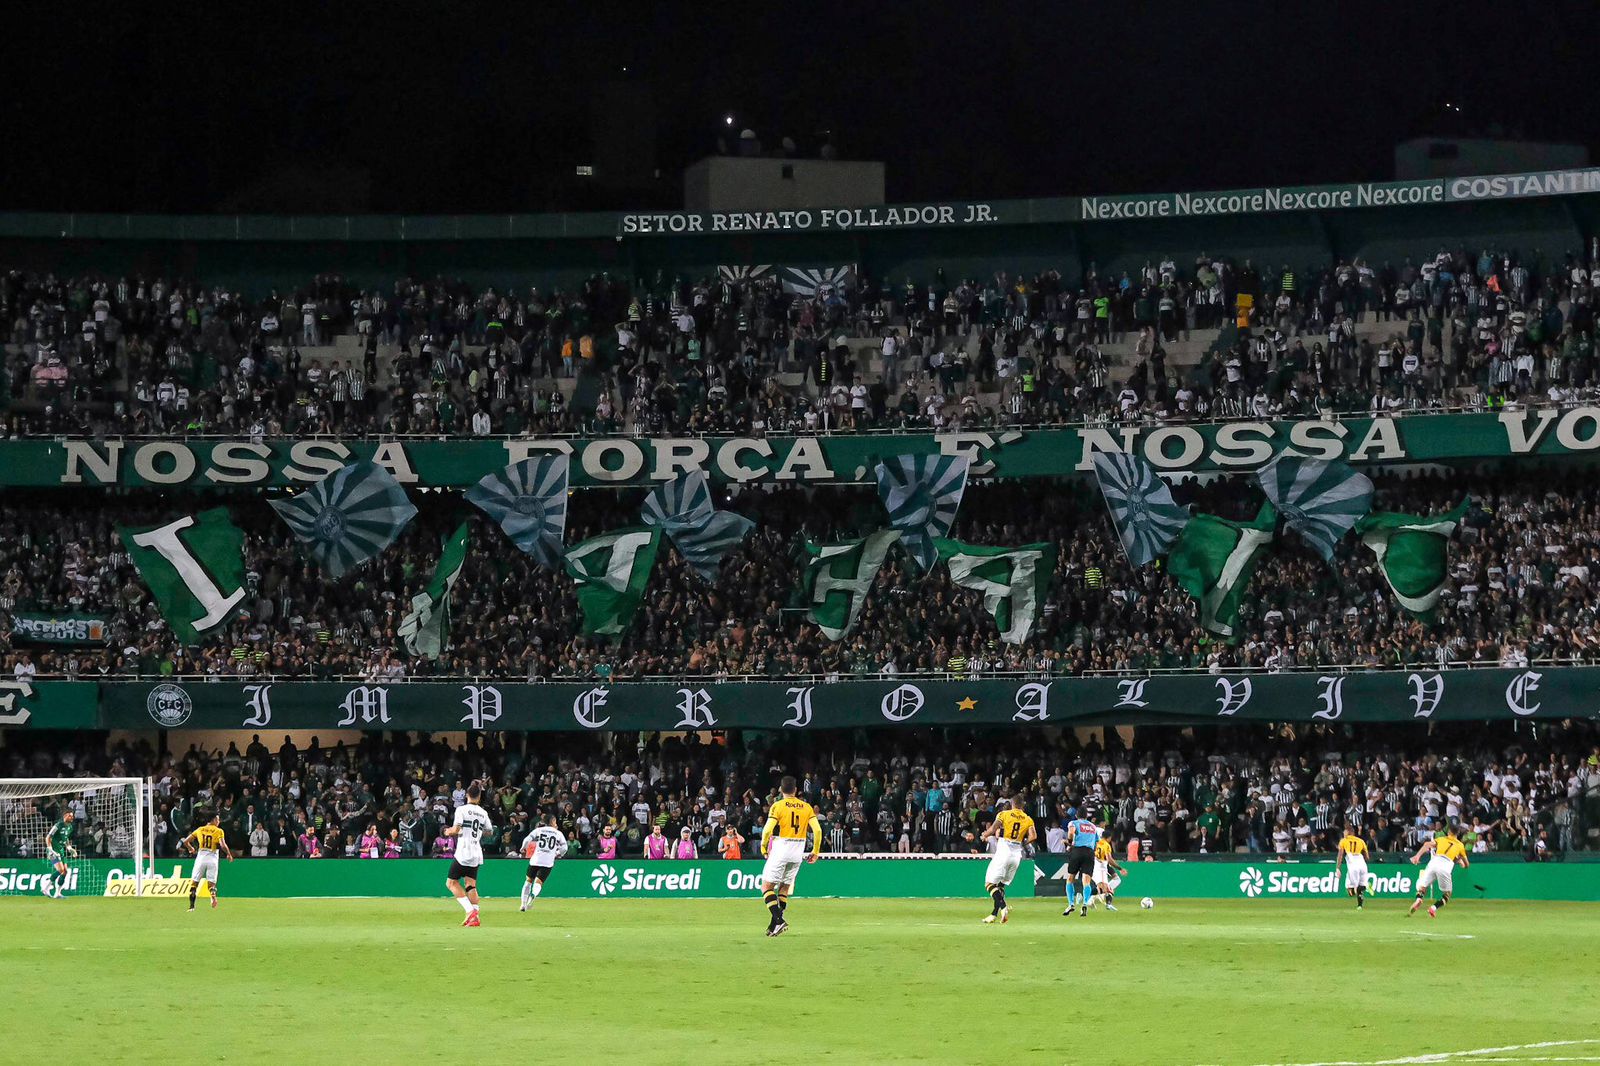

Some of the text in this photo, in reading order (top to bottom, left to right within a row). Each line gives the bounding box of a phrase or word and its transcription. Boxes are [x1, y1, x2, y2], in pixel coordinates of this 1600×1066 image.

[1081, 183, 1444, 220] Nexcore Nexcore Nexcore Nexcore
[623, 204, 998, 233] SETOR RENATO FOLLADOR JR.
[60, 440, 419, 484] NOSSA
[1074, 418, 1406, 471] NOSSA
[472, 818, 480, 838] 9
[791, 811, 800, 835] 4
[1010, 821, 1021, 840] 8
[202, 833, 213, 849] 10
[538, 833, 556, 850] 50
[1349, 840, 1357, 853] 11
[1444, 841, 1454, 854] 7
[622, 868, 702, 891] Sicredi
[1267, 871, 1341, 893] Sicredi
